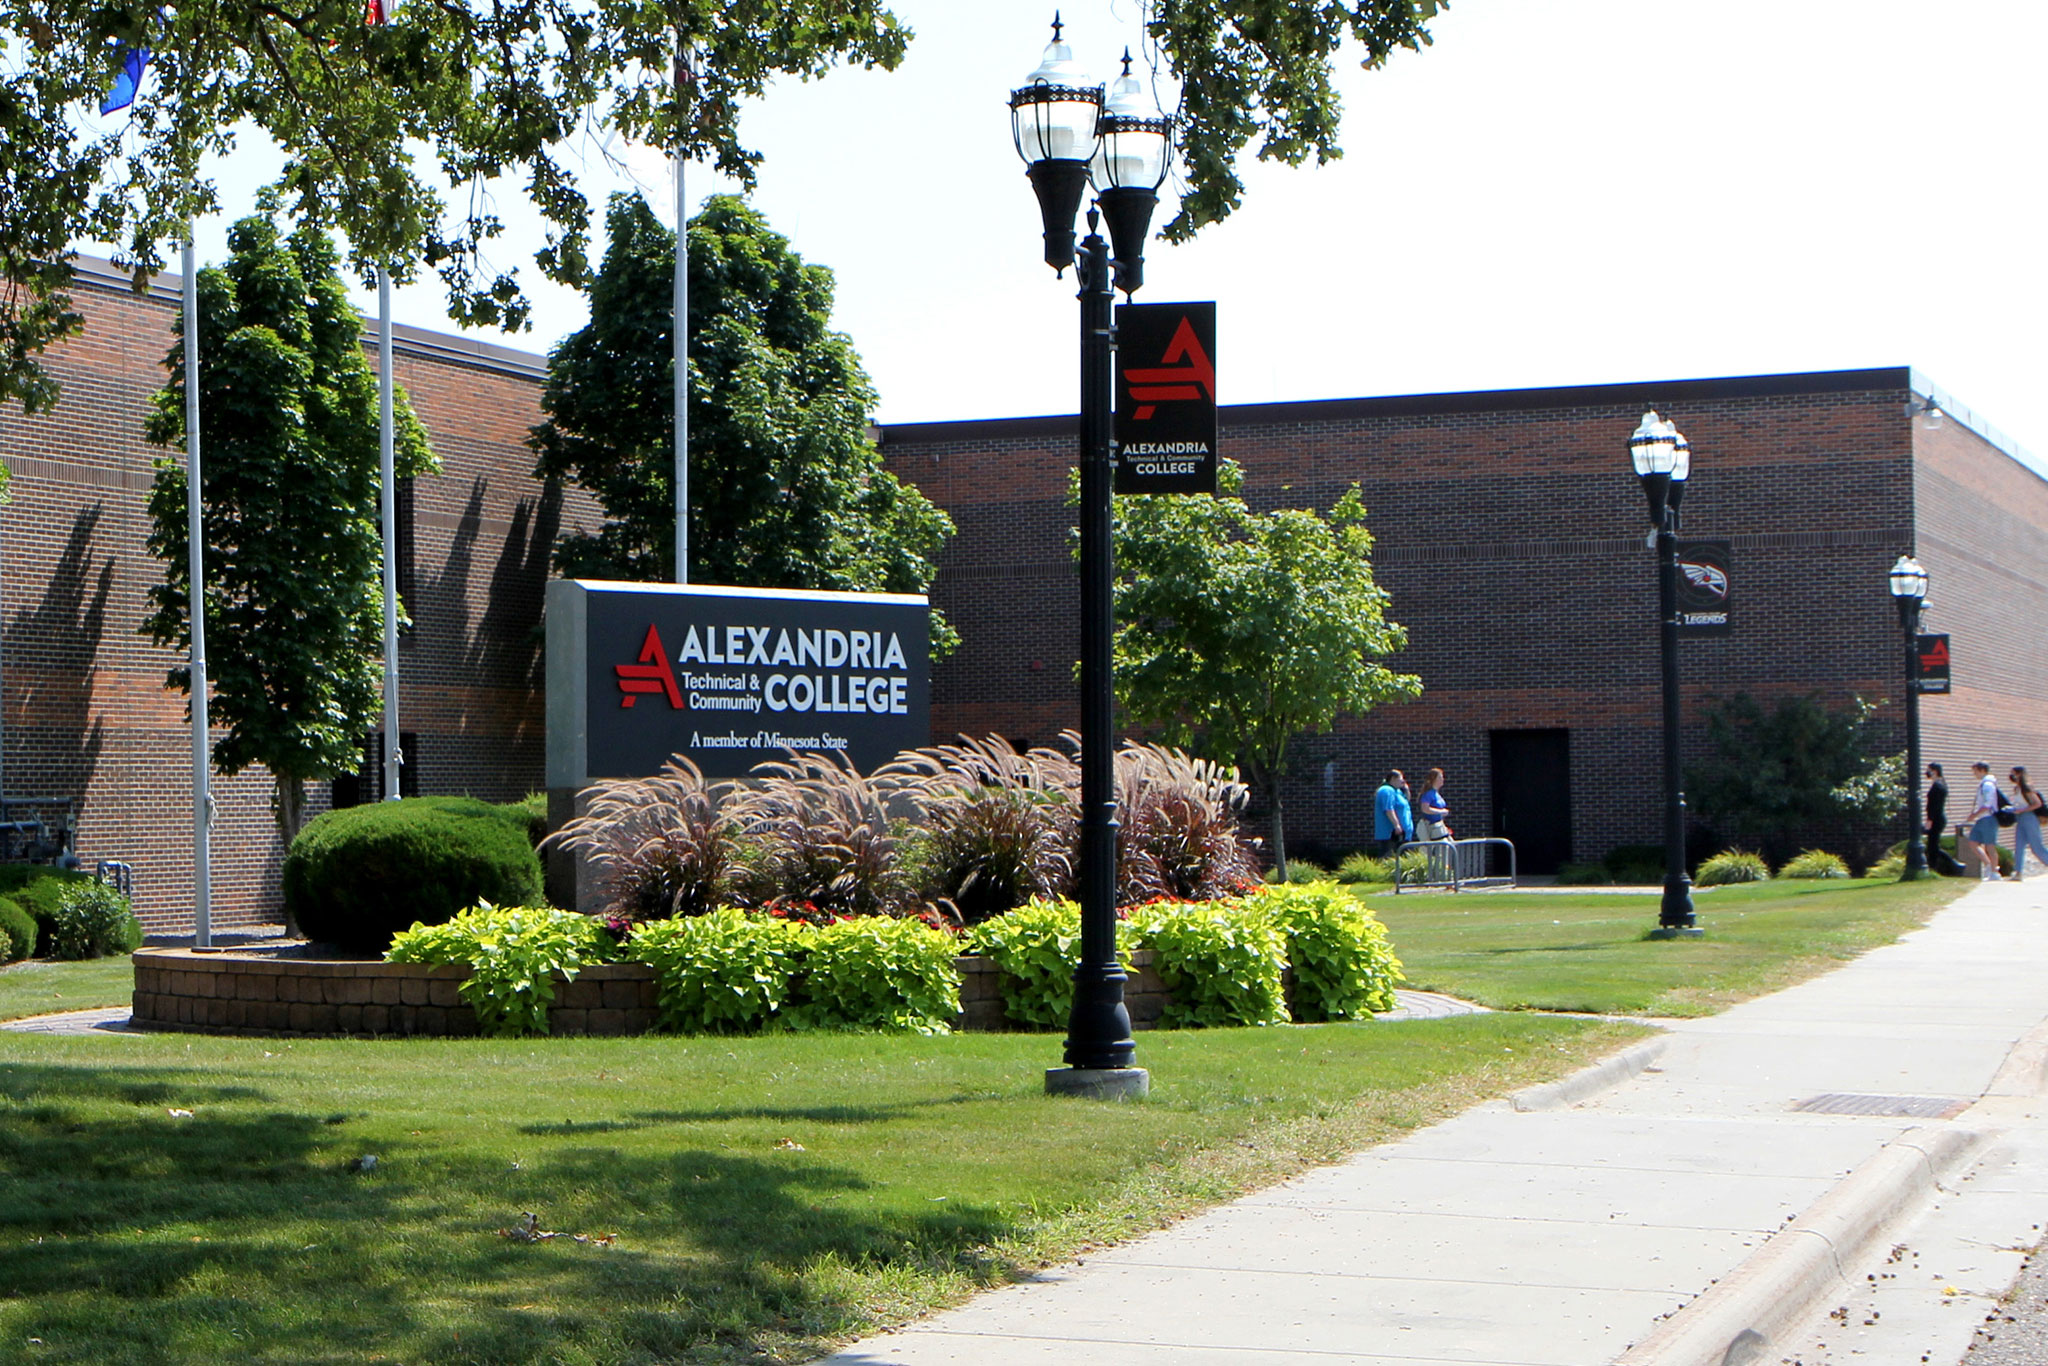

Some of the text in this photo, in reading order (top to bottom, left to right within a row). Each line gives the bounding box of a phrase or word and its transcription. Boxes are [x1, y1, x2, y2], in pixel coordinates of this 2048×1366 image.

[1123, 442, 1208, 455] ALEXANDRIA
[1136, 462, 1195, 474] COLLEGE
[1684, 613, 1728, 625] LEGENDS
[678, 624, 908, 670] ALEXANDRIA
[682, 671, 760, 690] Technical &
[689, 691, 762, 714] Community
[764, 673, 908, 714] COLLEGE
[690, 730, 848, 749] A member of Minnesota State
